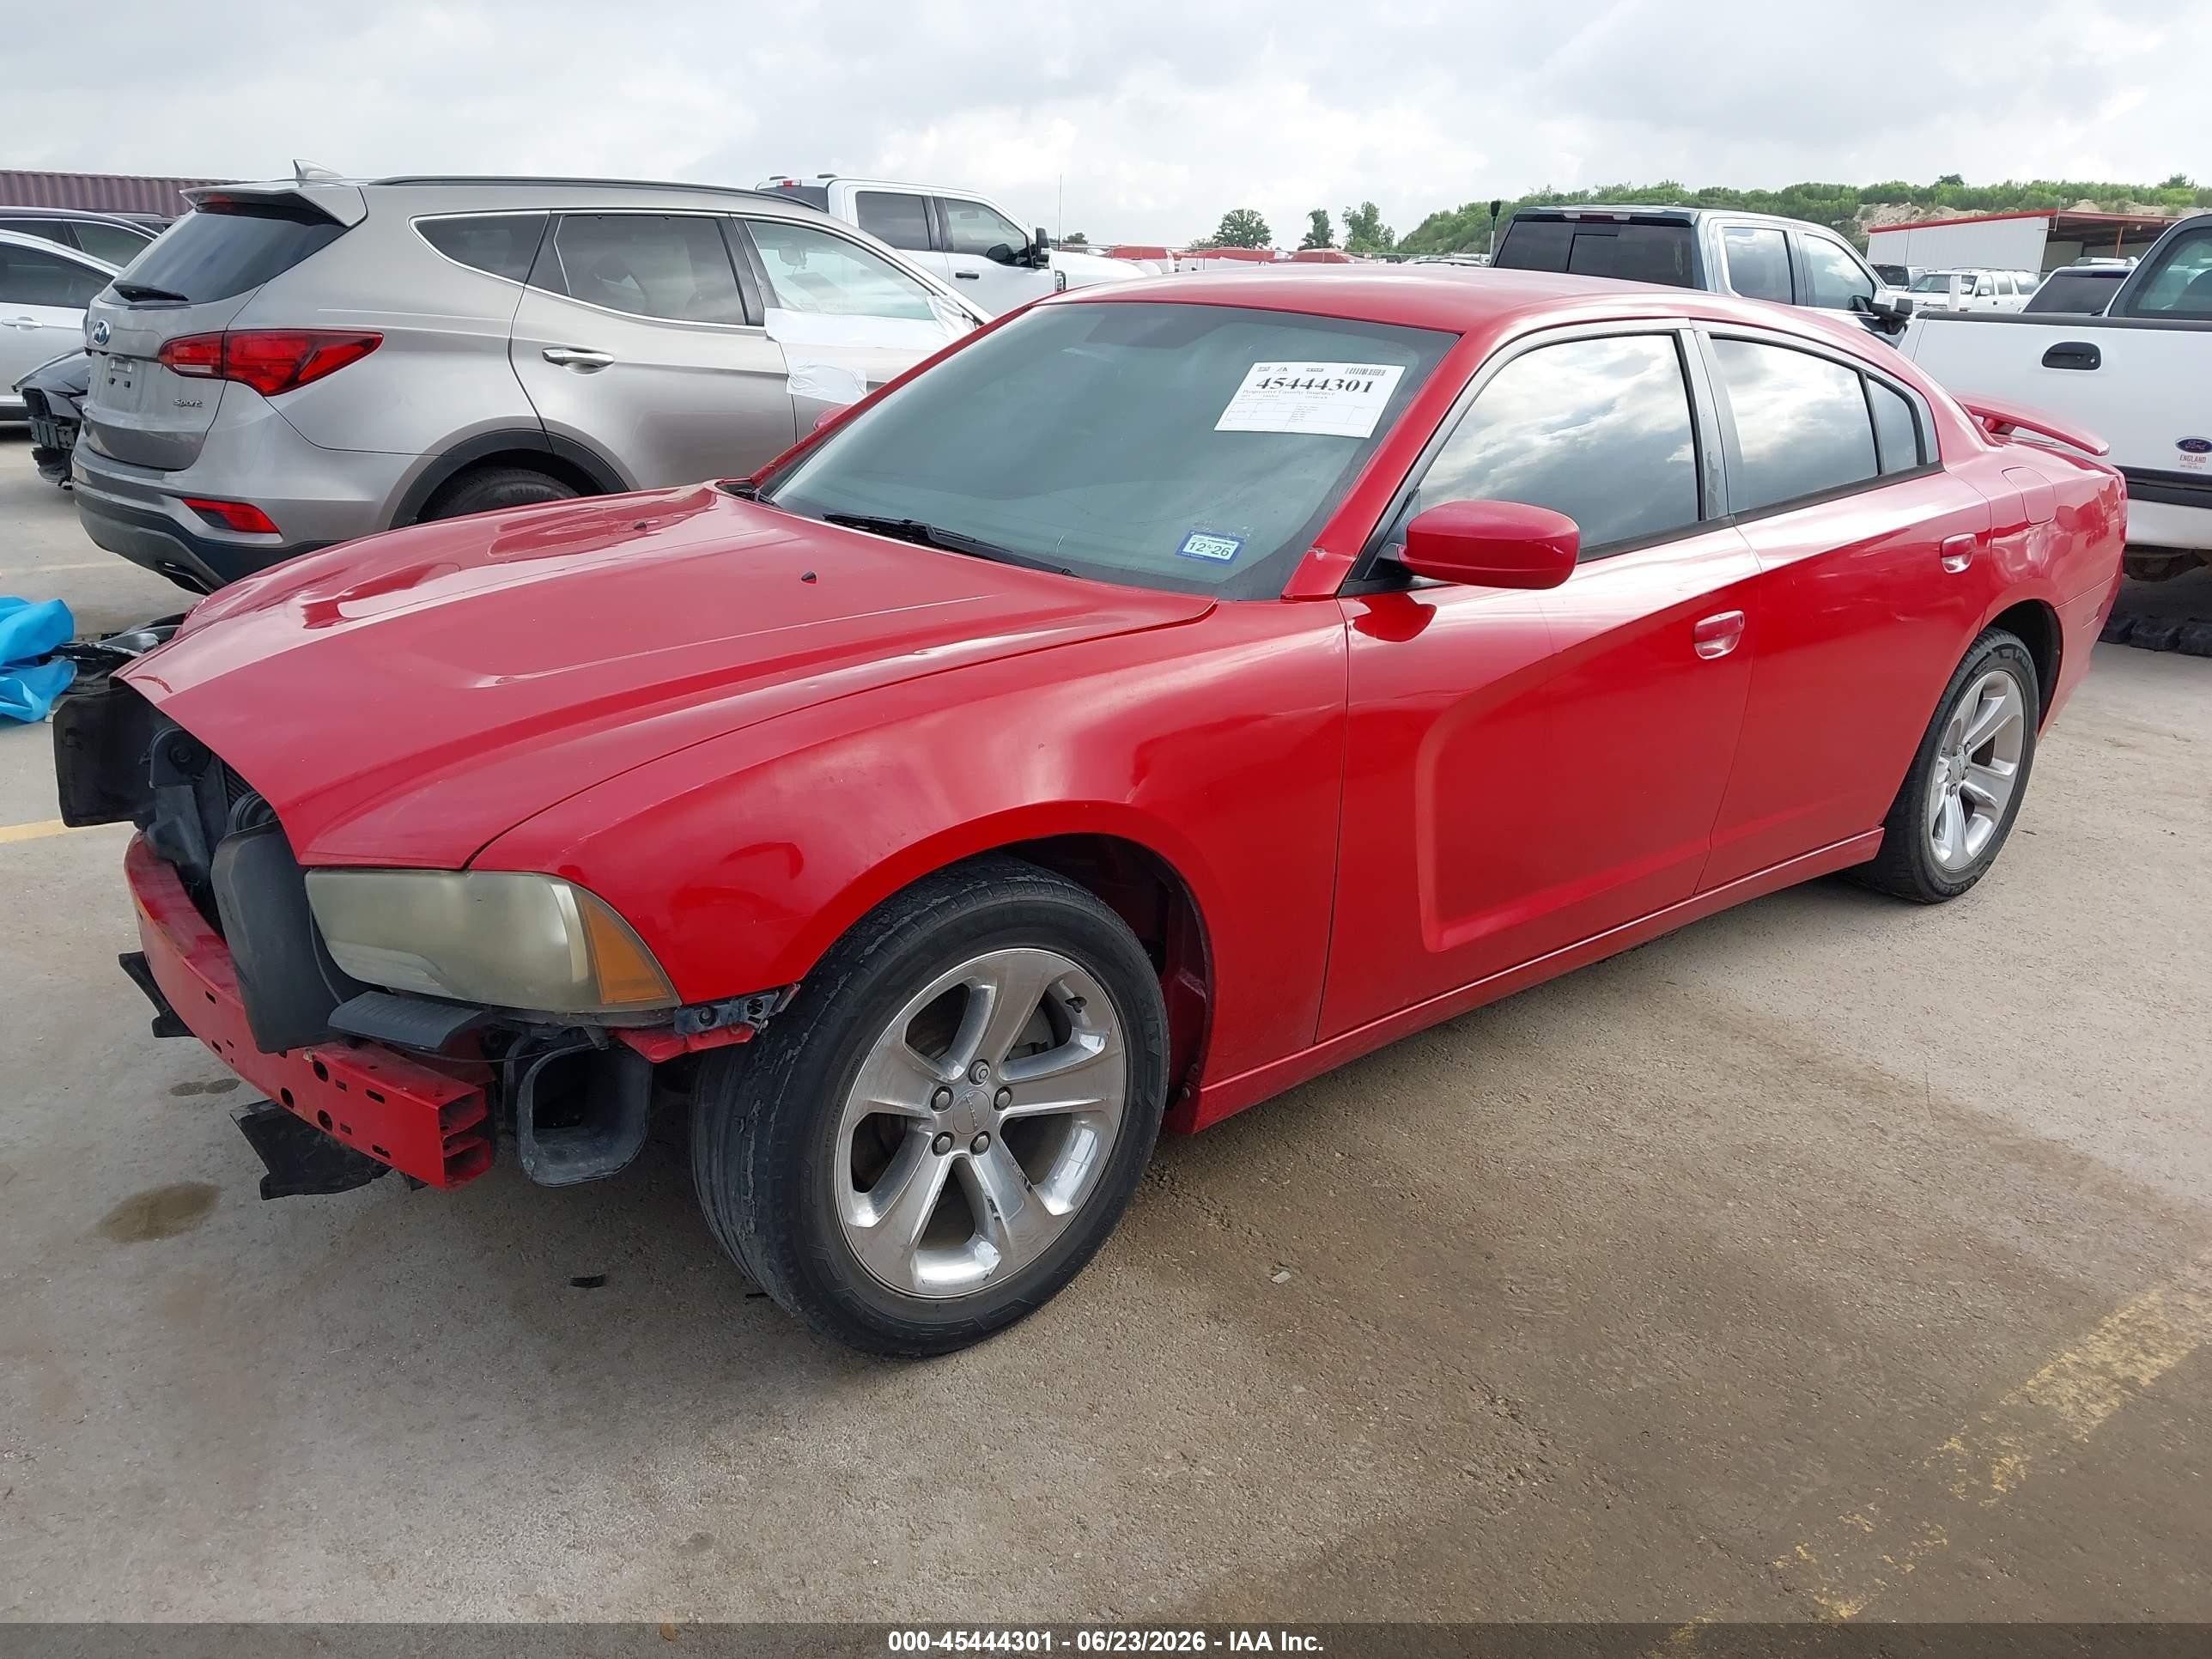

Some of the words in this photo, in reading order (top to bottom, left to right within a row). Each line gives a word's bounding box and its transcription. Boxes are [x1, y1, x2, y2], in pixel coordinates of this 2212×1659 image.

[1255, 377, 1375, 393] 45444301
[173, 398, 203, 408] Sport
[2179, 454, 2207, 464] ENGLAND
